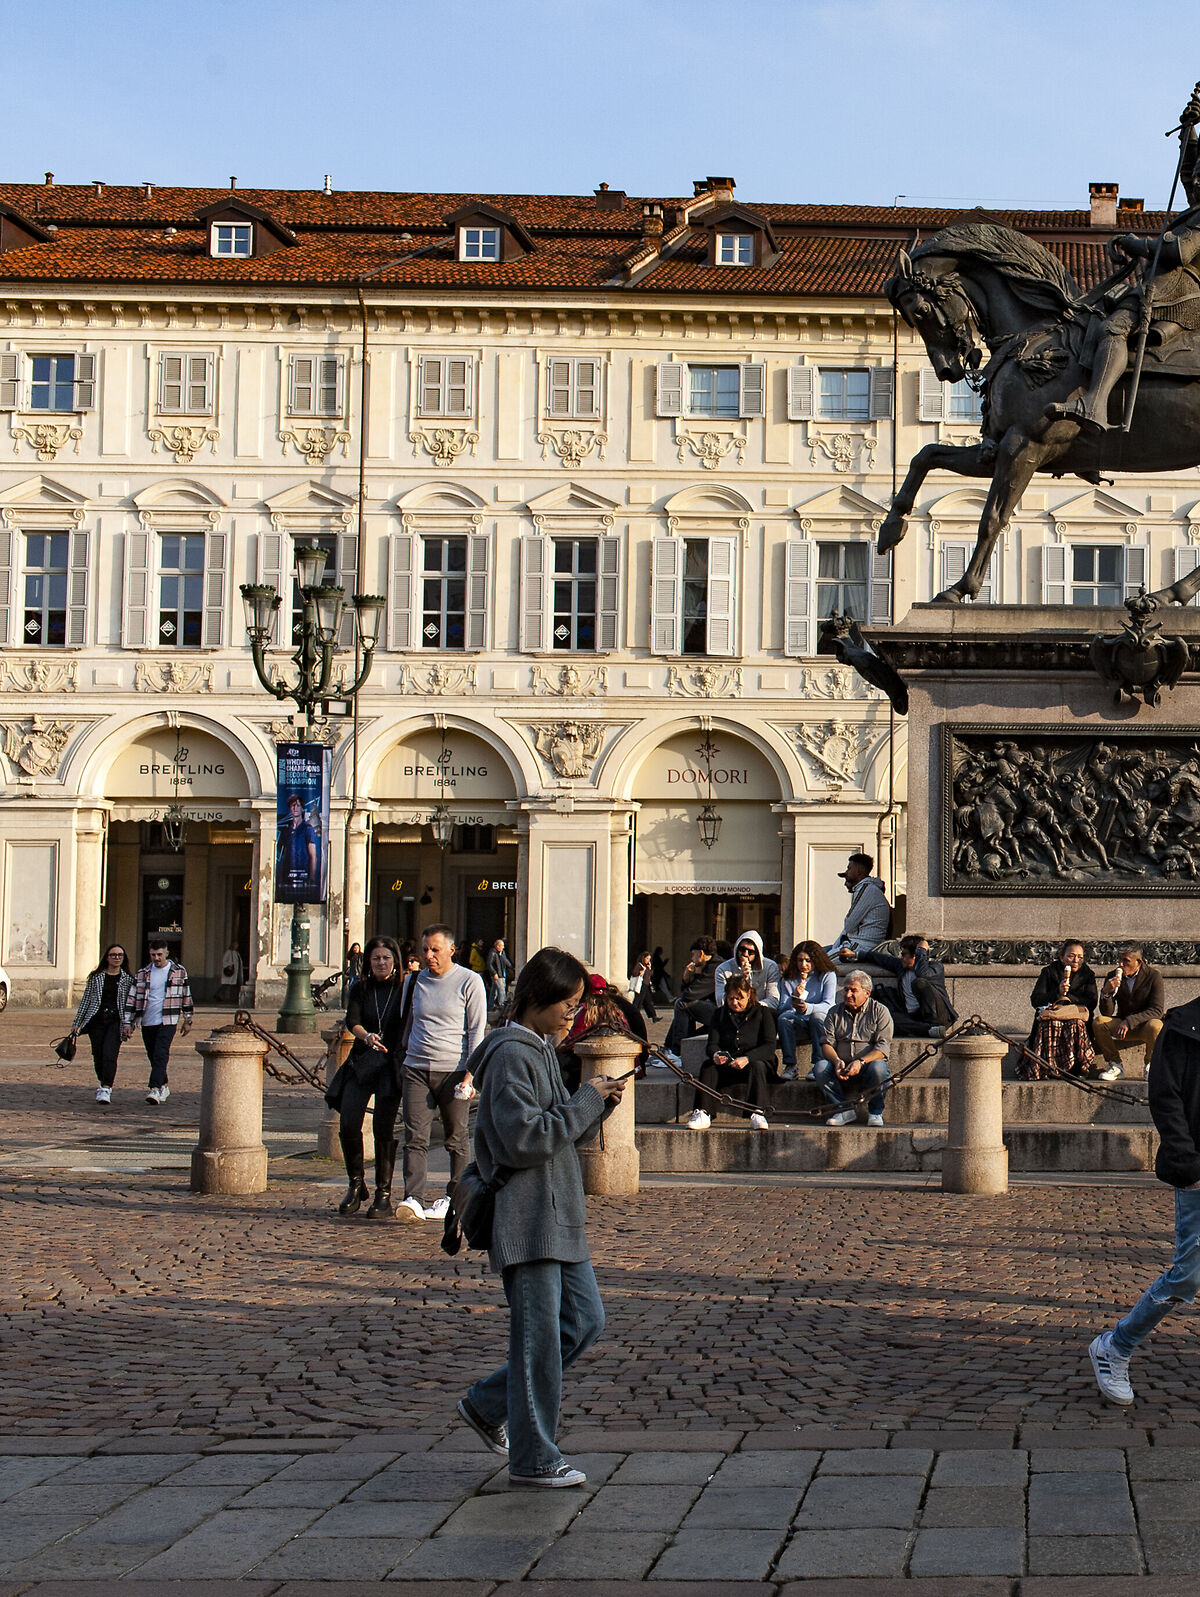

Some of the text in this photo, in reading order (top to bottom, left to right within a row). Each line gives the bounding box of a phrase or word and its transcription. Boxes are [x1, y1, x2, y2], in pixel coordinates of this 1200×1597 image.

[140, 765, 225, 774] BREITLING
[404, 766, 488, 776] BREITLING
[667, 769, 748, 784] DOMORI
